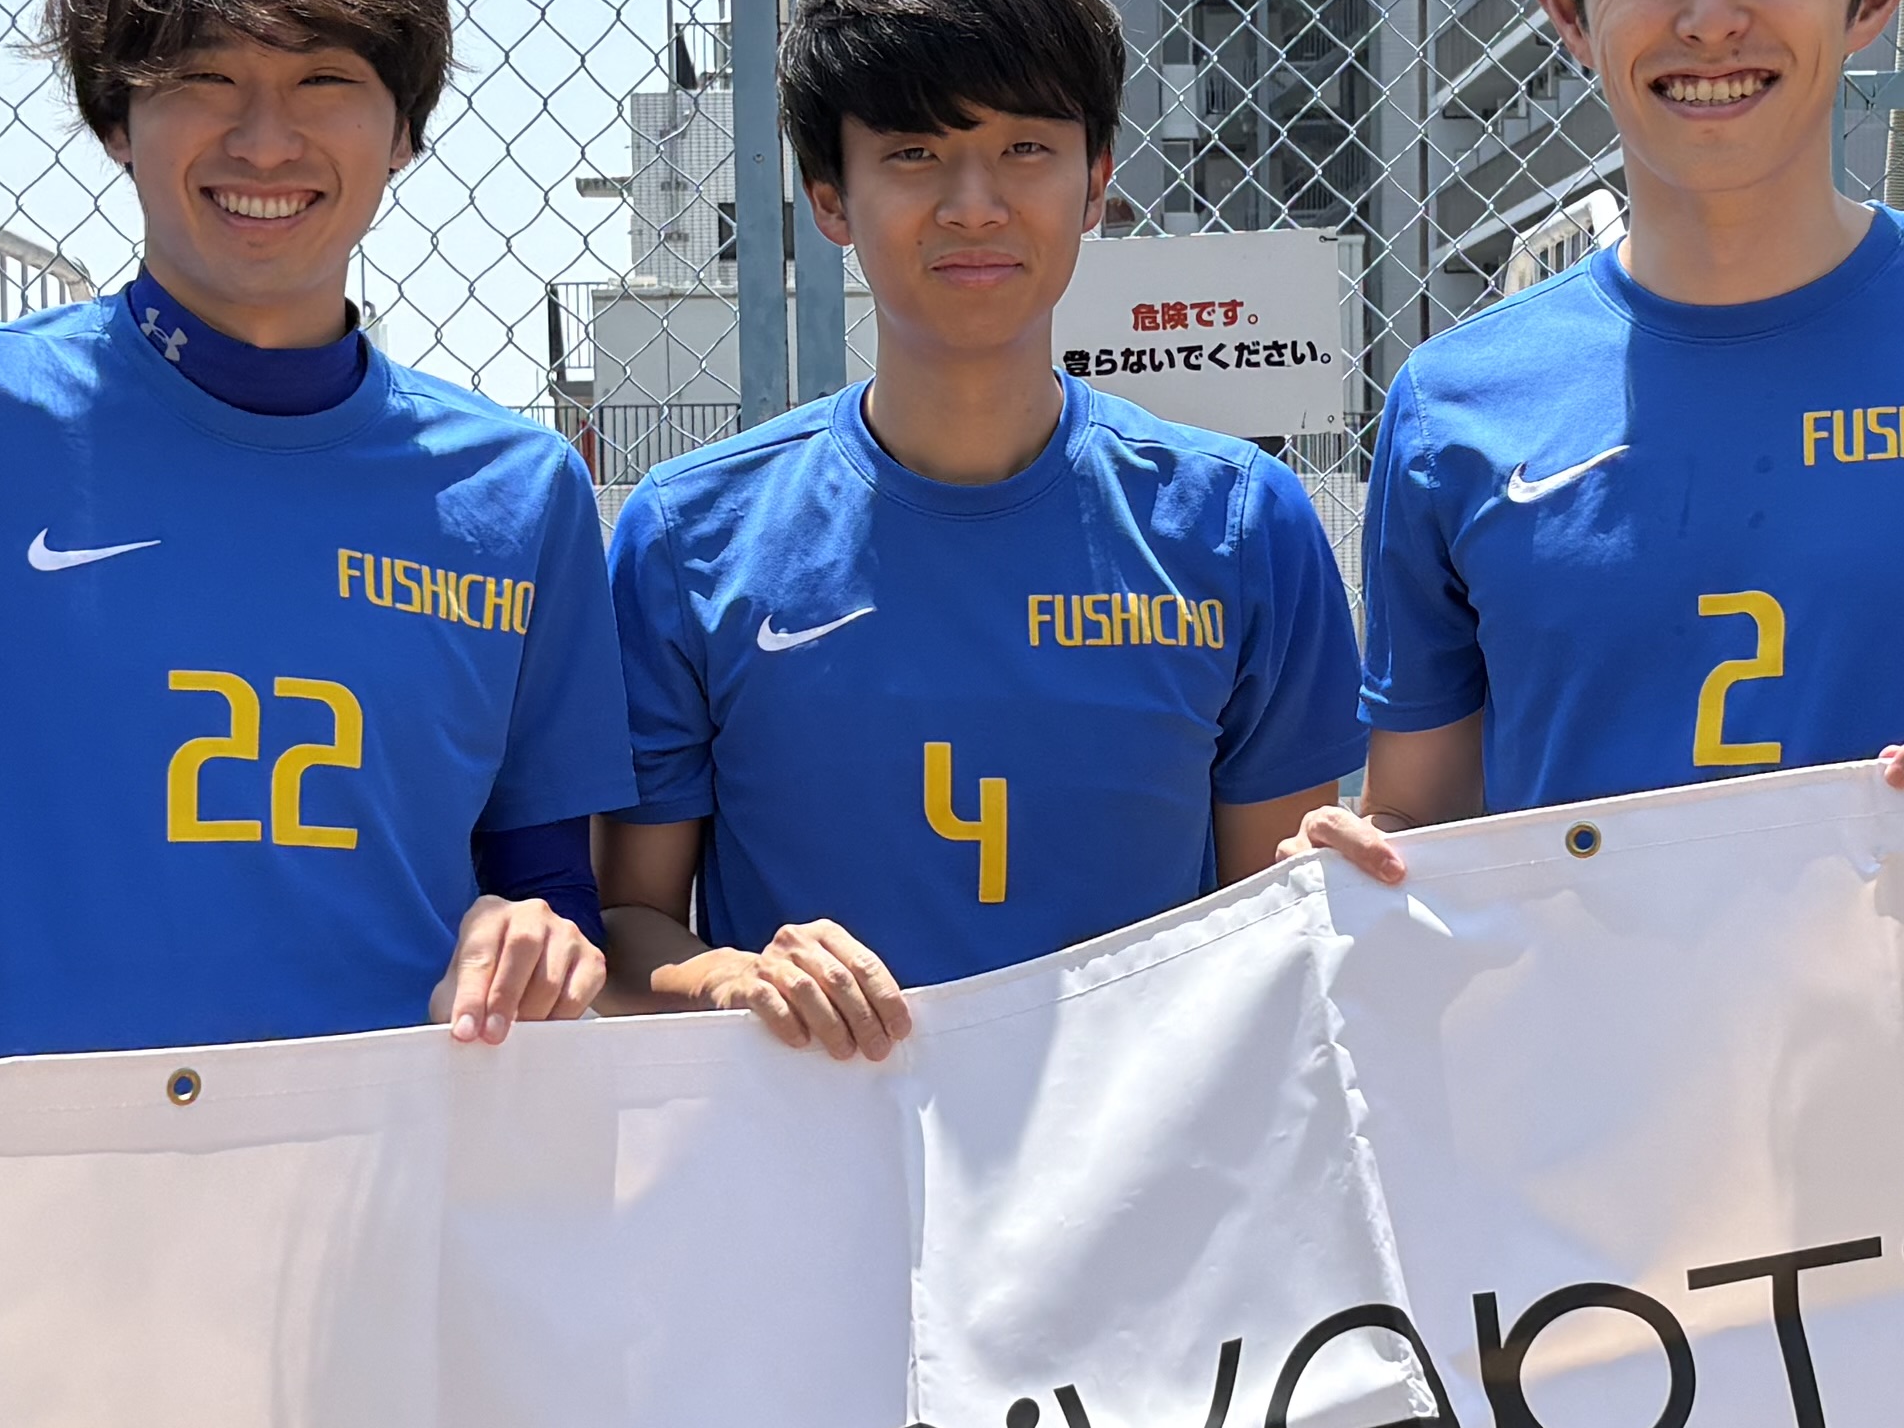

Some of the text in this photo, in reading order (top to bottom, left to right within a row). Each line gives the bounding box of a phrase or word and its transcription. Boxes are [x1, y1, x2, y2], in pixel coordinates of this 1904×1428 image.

[1131, 298, 1259, 332] 危険です。
[1063, 340, 1333, 378] 登らないでください。
[337, 548, 534, 635] FUSHICHO
[1028, 593, 1224, 649] FUSHICHO
[1693, 590, 1786, 766] 2
[167, 670, 363, 850] 22
[923, 741, 1008, 903] 4
